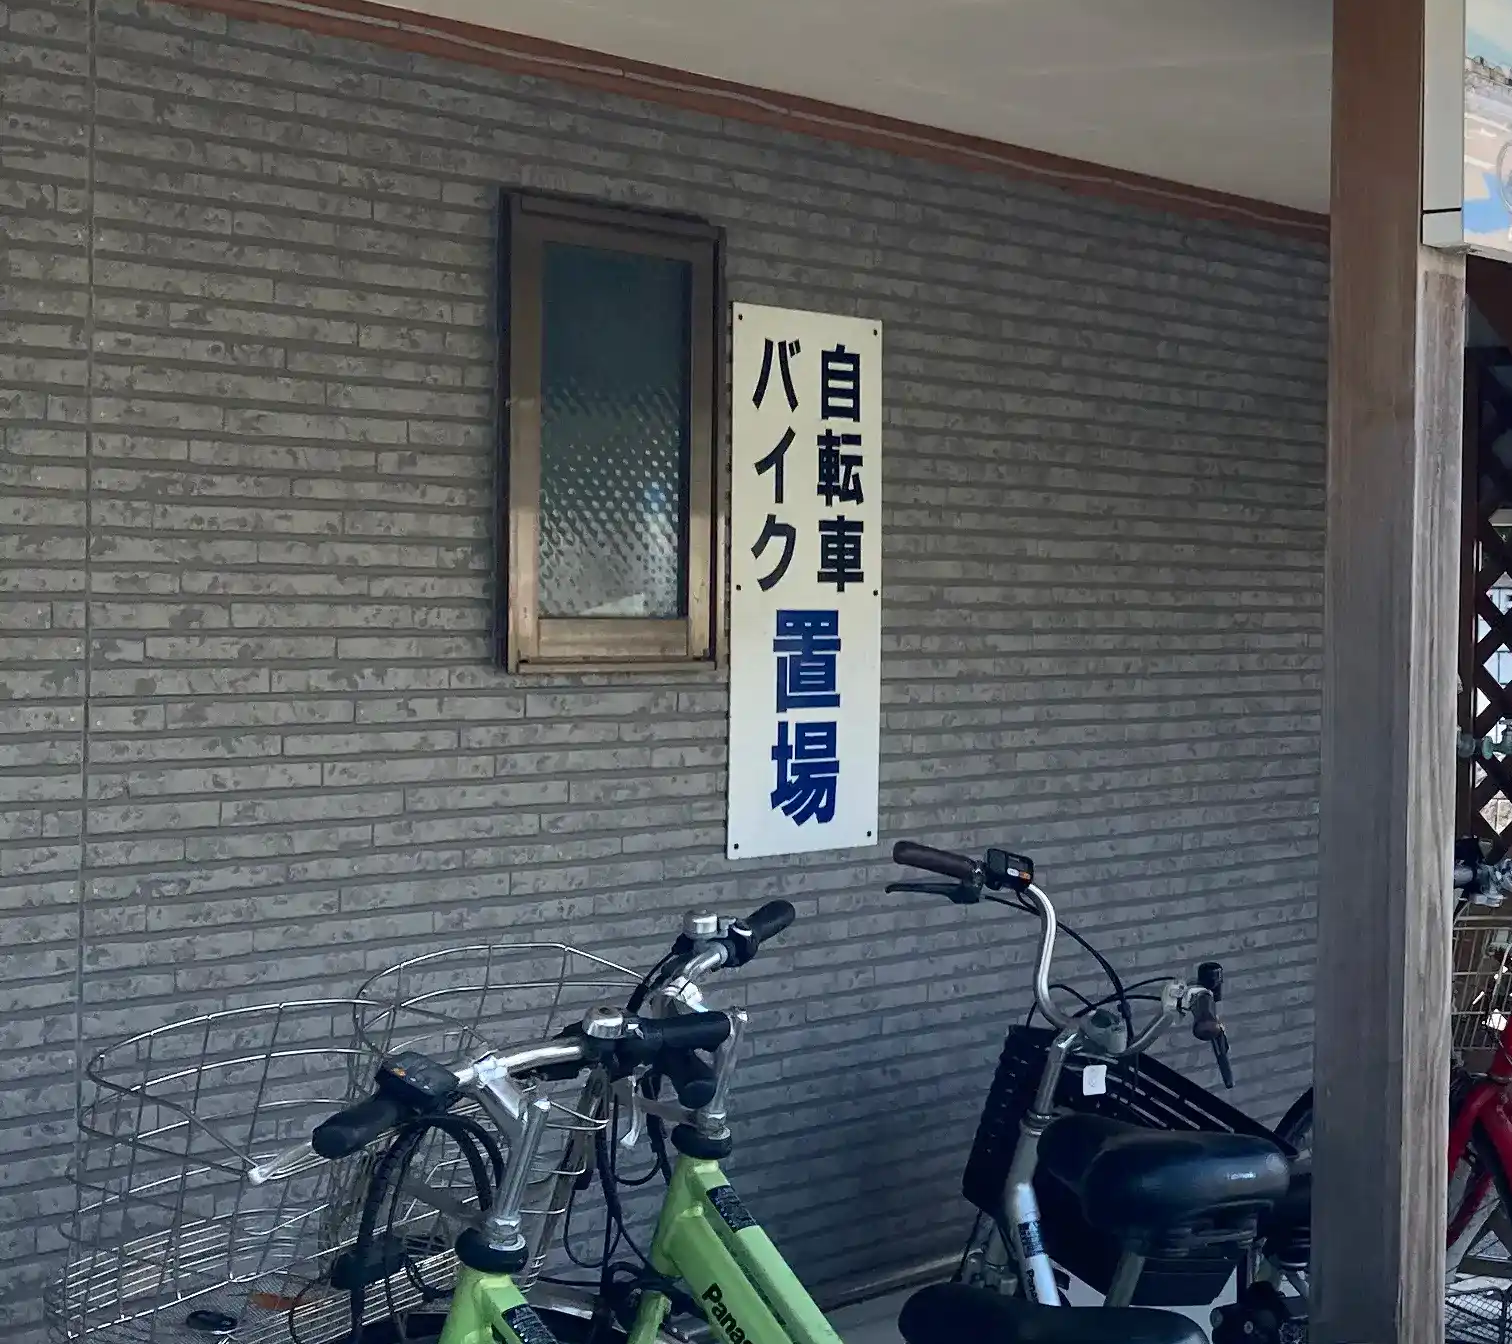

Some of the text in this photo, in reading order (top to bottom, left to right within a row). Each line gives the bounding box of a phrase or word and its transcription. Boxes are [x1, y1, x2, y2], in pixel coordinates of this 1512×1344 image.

[750, 336, 802, 593] バイク
[816, 343, 866, 593] 自転車
[769, 607, 842, 827] 置場
